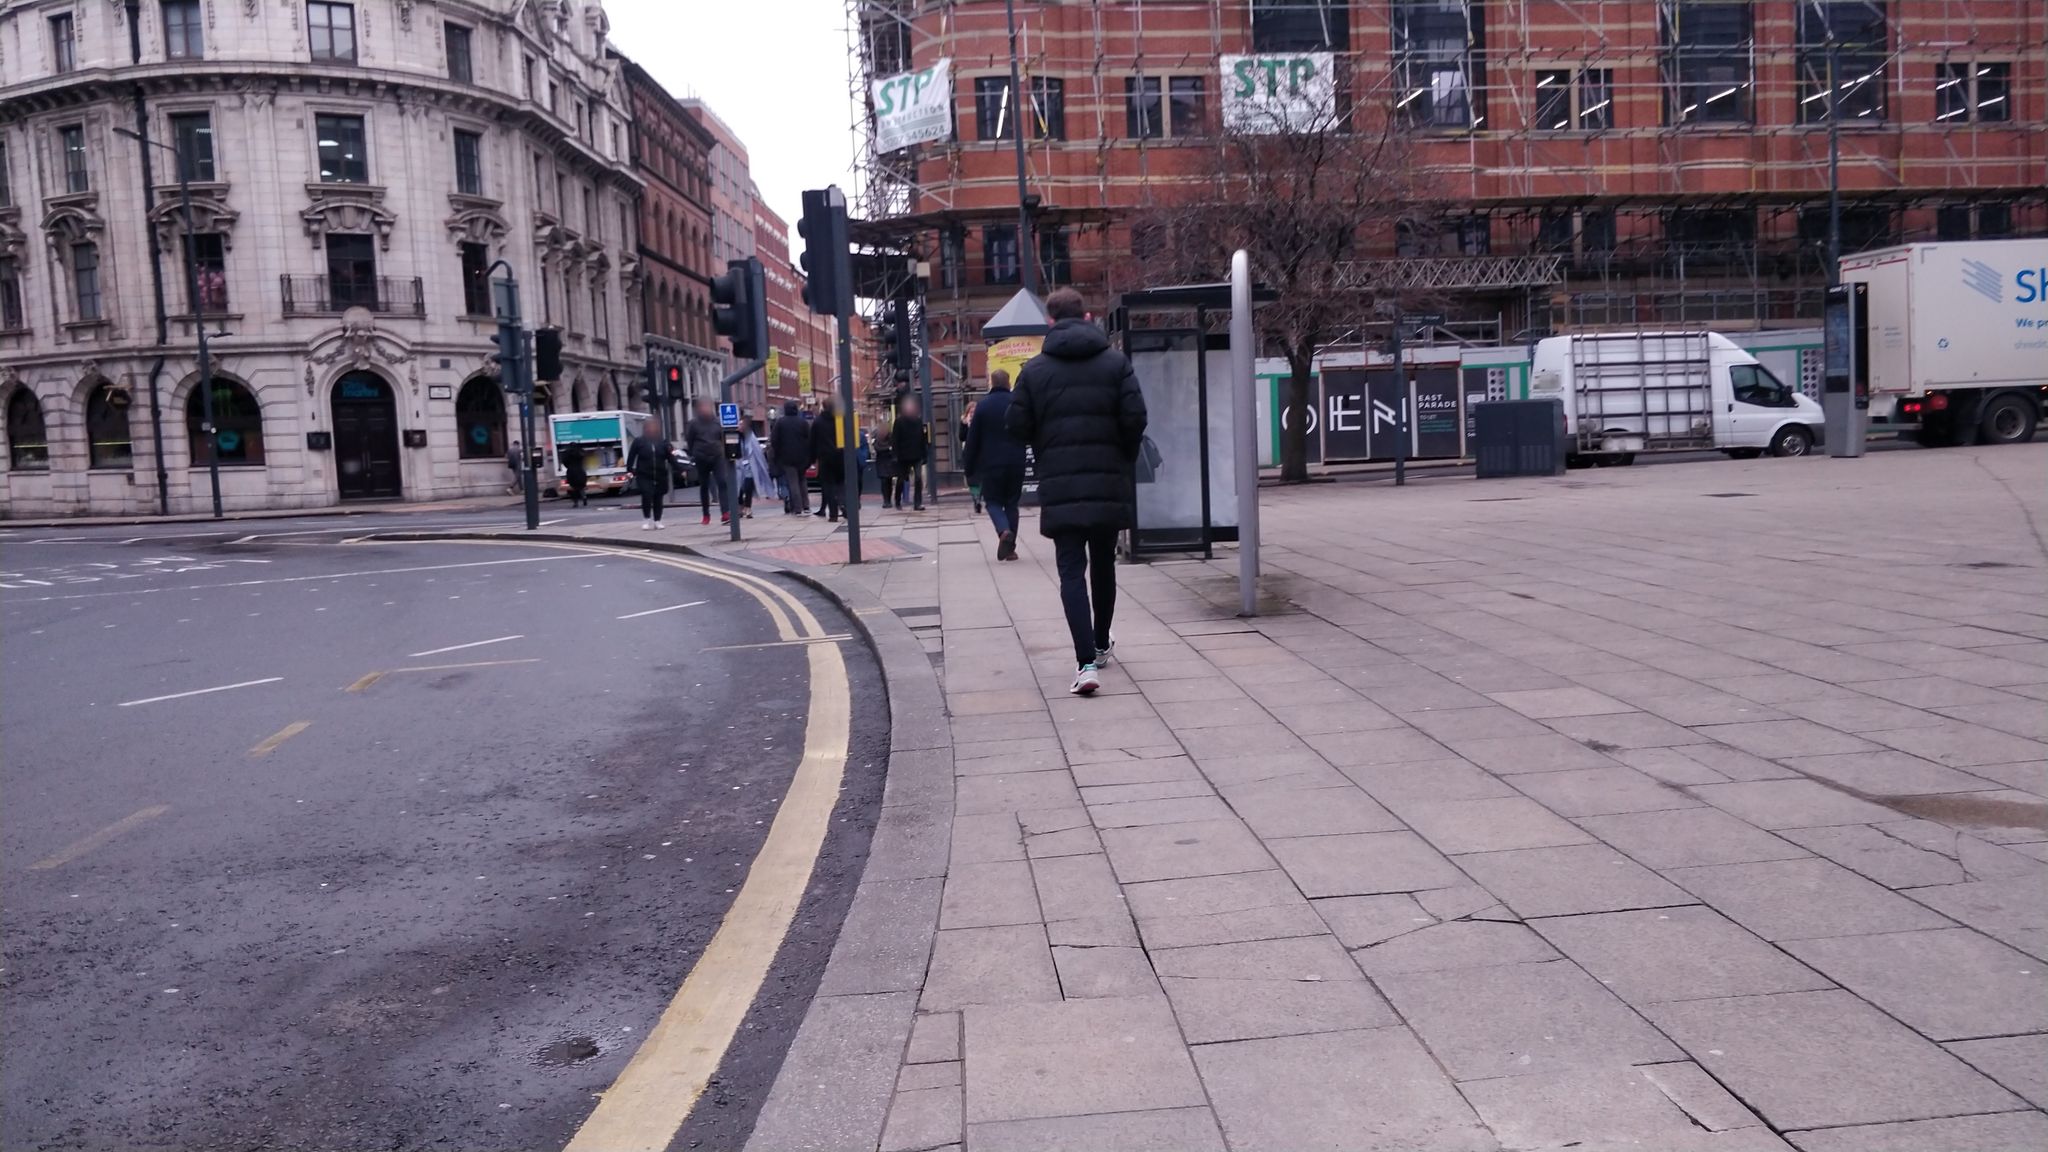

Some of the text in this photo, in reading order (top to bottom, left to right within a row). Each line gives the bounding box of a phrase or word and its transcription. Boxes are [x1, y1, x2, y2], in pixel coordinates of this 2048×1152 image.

[1234, 59, 1315, 97] STP
[876, 69, 935, 117] STP
[1418, 394, 1443, 402] EAST
[1418, 400, 1457, 409] PARADE
